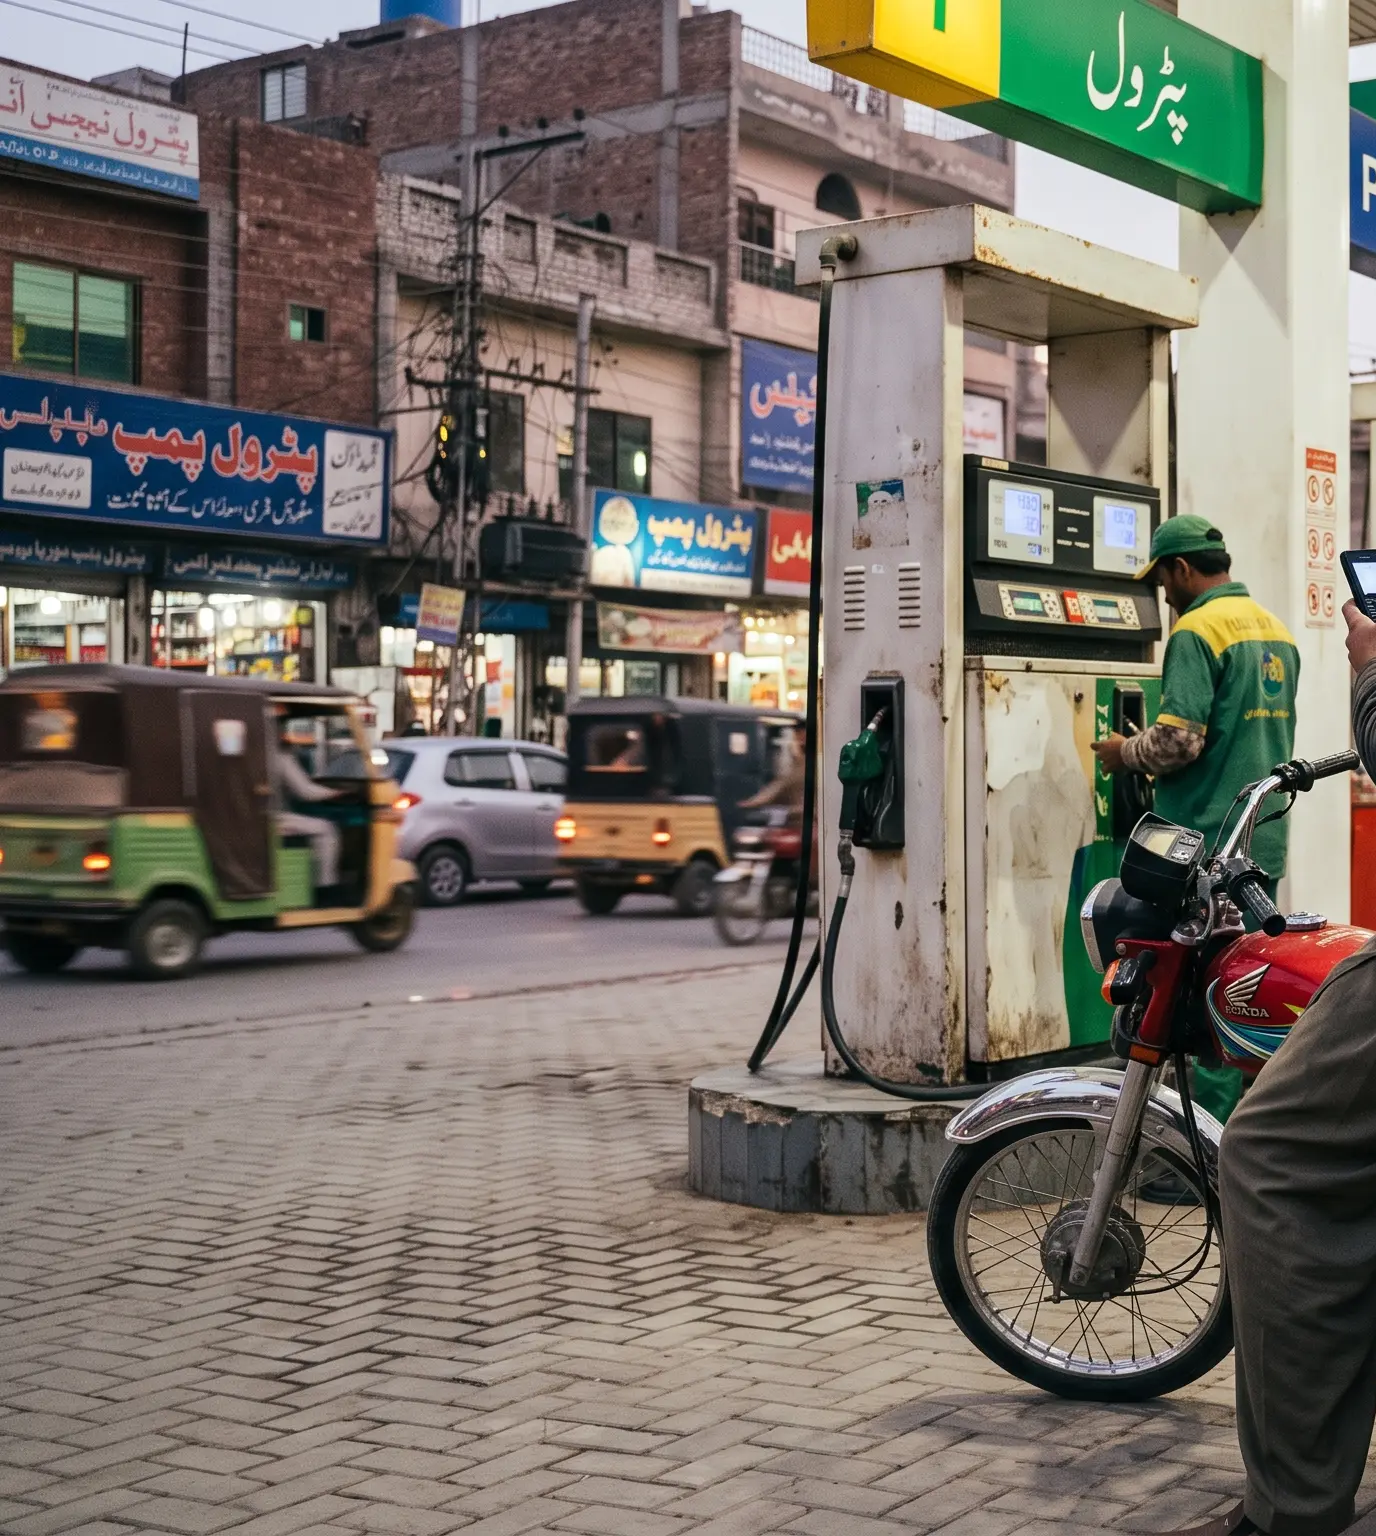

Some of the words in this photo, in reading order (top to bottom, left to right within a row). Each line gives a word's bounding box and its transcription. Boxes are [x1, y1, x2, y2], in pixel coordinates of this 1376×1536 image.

[1087, 10, 1189, 146] پٹرول
[112, 422, 206, 483] پمپ
[211, 421, 319, 495] پٹرول
